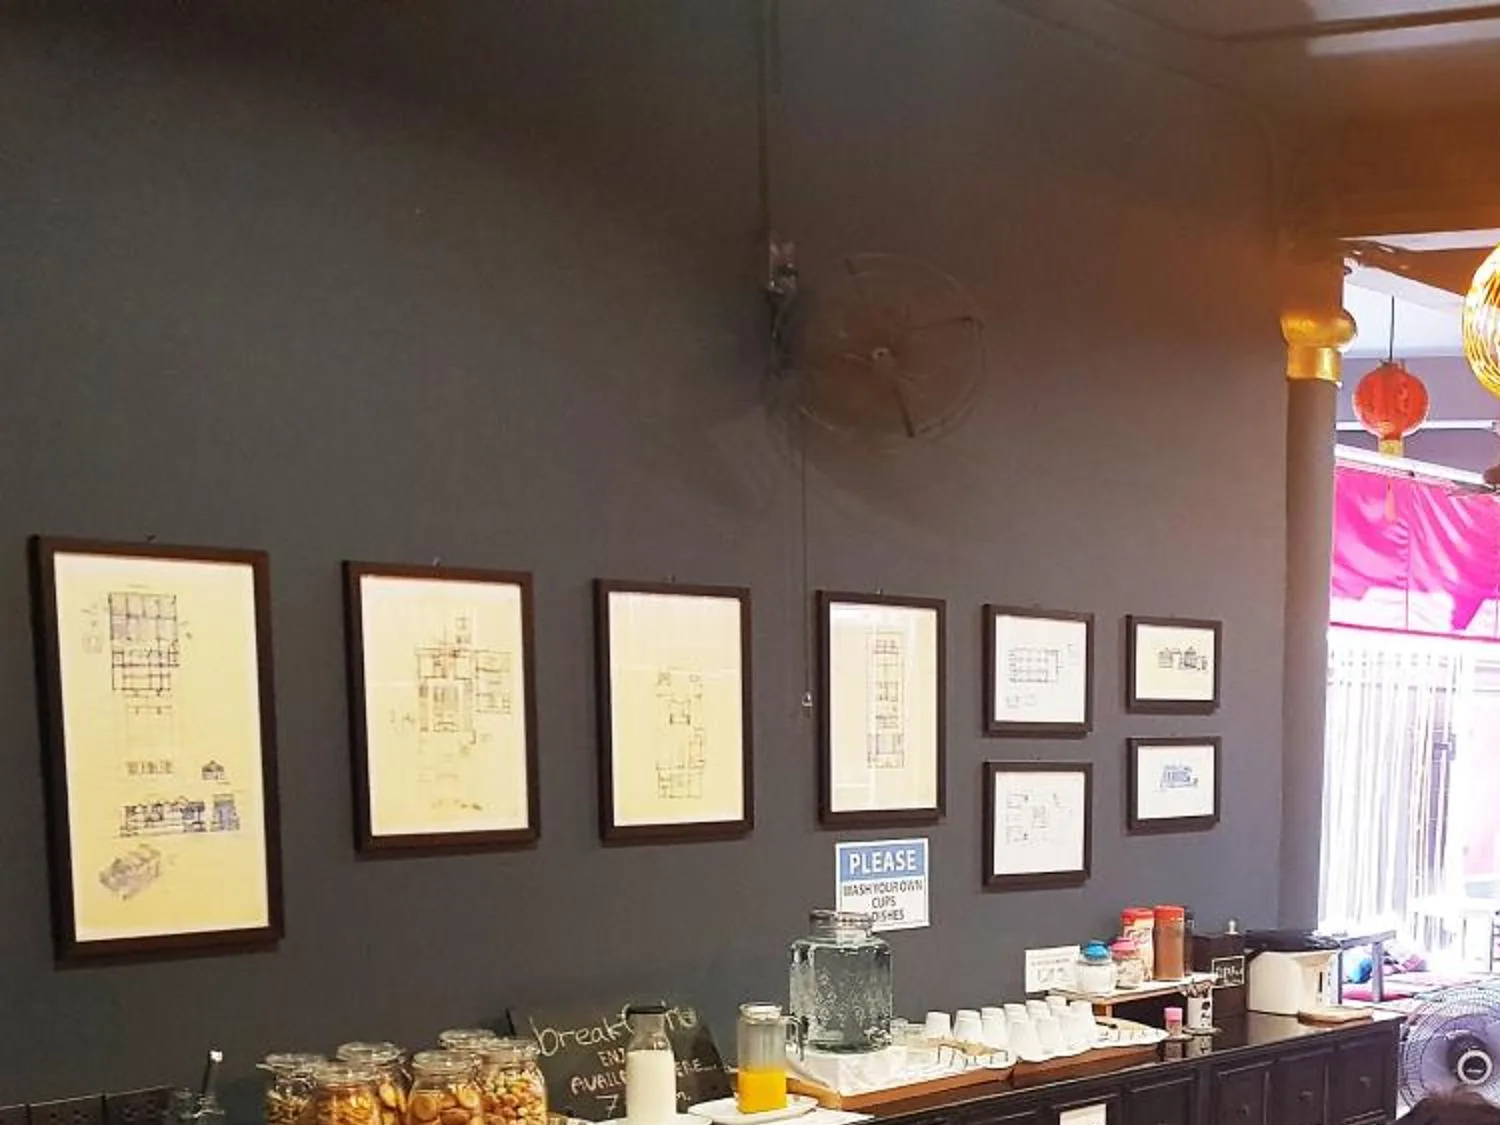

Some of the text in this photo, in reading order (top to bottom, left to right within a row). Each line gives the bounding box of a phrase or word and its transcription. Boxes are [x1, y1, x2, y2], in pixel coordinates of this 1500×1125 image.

[849, 849, 917, 875] PLEASE
[872, 881, 898, 894] YOUR
[899, 879, 923, 892] OWN
[872, 895, 896, 908] CUPS
[872, 908, 904, 922] DISHES
